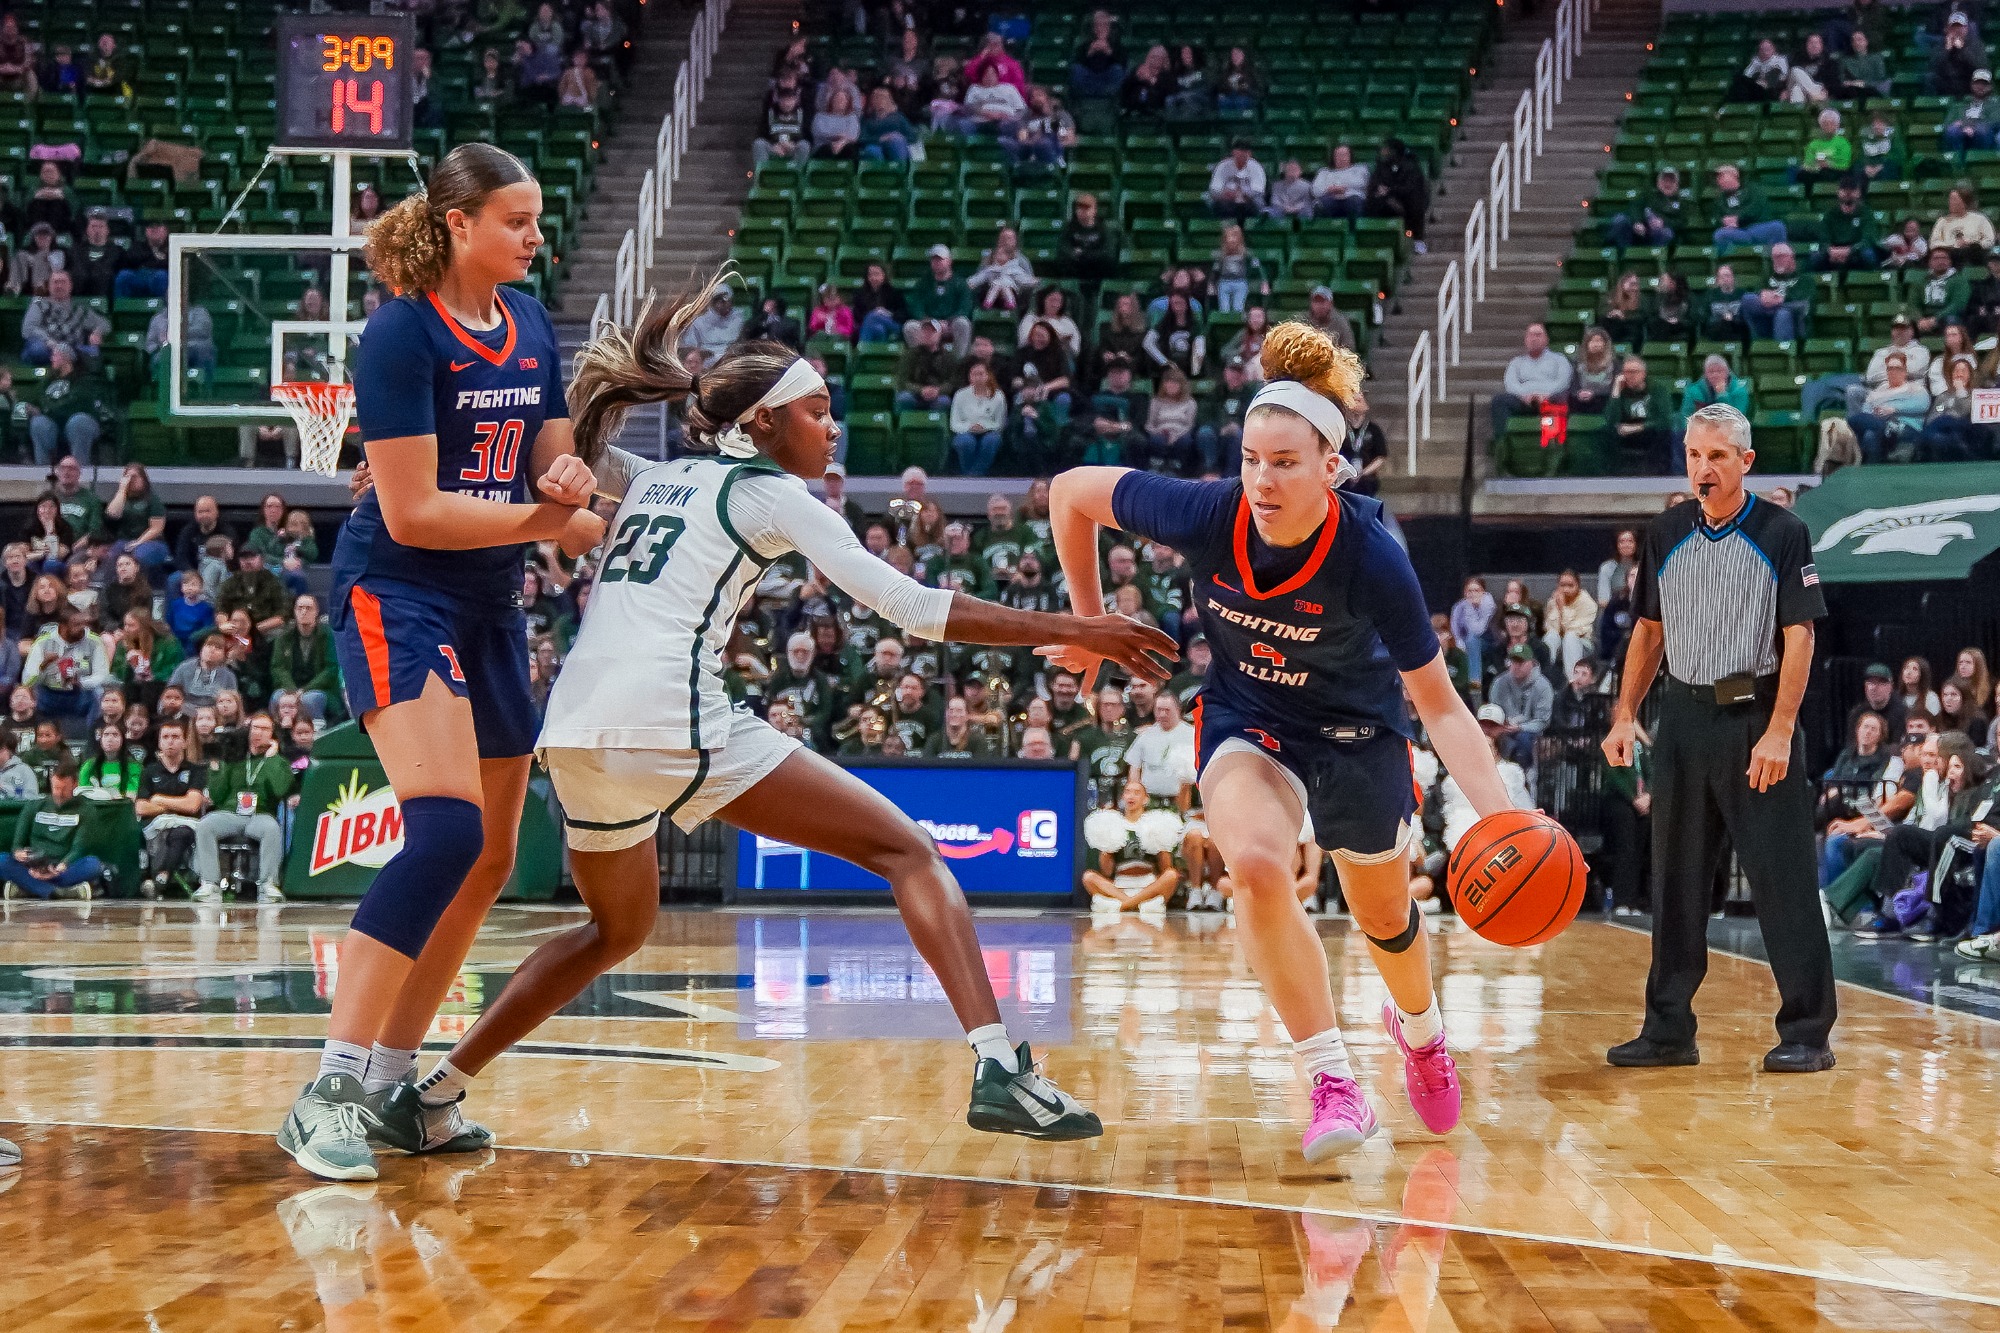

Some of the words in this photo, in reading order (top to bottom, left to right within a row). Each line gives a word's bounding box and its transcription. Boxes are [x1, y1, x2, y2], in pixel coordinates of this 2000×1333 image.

[322, 35, 395, 73] 3:09
[331, 79, 384, 135] 14
[456, 386, 541, 410] FIGHTING
[460, 419, 525, 482] 30
[638, 483, 699, 507] BROWN
[599, 513, 686, 585] 23
[1207, 598, 1322, 642] FIGHTING
[1239, 661, 1309, 687] ILLINI
[1251, 642, 1287, 667] 4
[1463, 844, 1524, 908] ELITE
